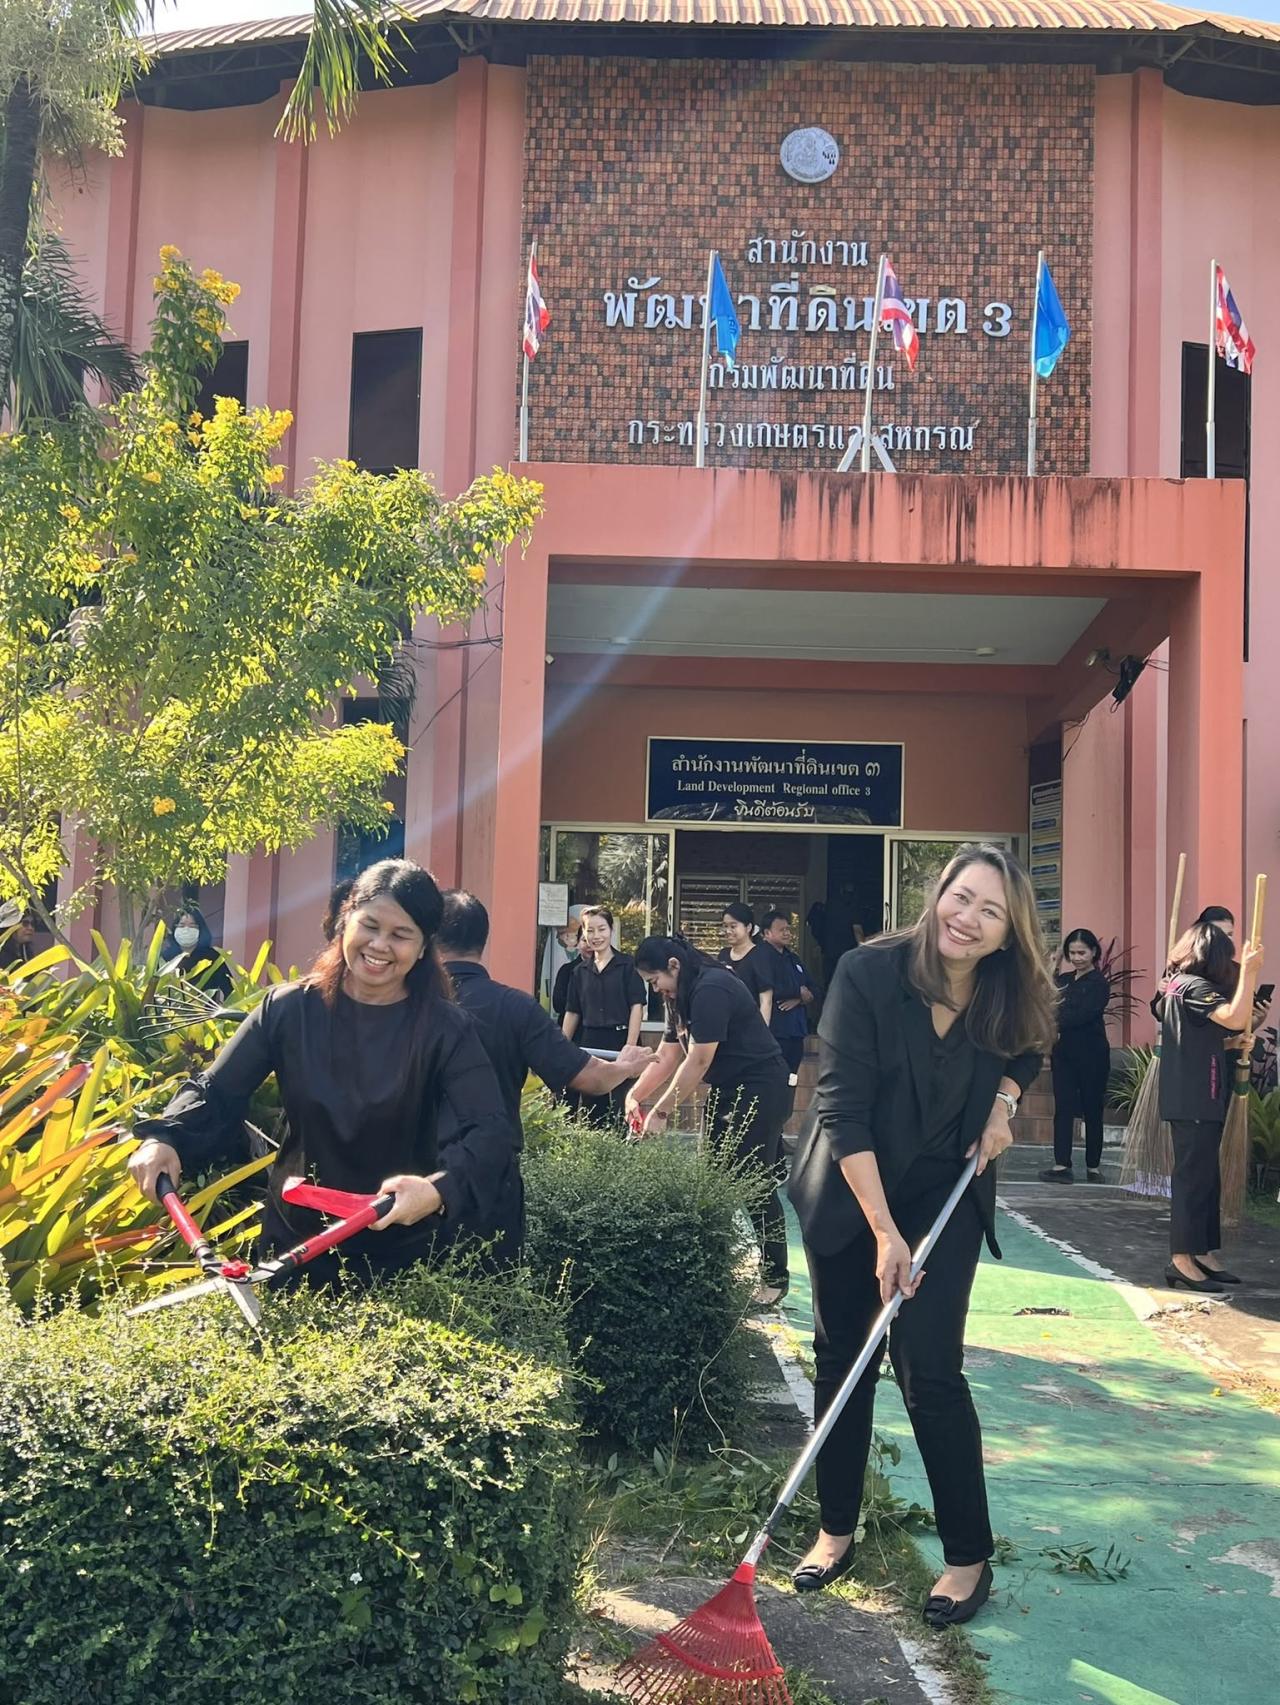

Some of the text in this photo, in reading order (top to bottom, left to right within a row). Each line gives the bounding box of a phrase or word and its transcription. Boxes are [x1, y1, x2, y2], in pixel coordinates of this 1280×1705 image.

[603, 271, 969, 335] พัฒาที่ดินขต
[982, 301, 1013, 338] 3
[672, 748, 860, 777] สำนักงานพัฒนาที่ดินเขต
[677, 779, 872, 797] Land Development Regional office 3
[733, 798, 816, 818] ยินดีต้อนรับ
